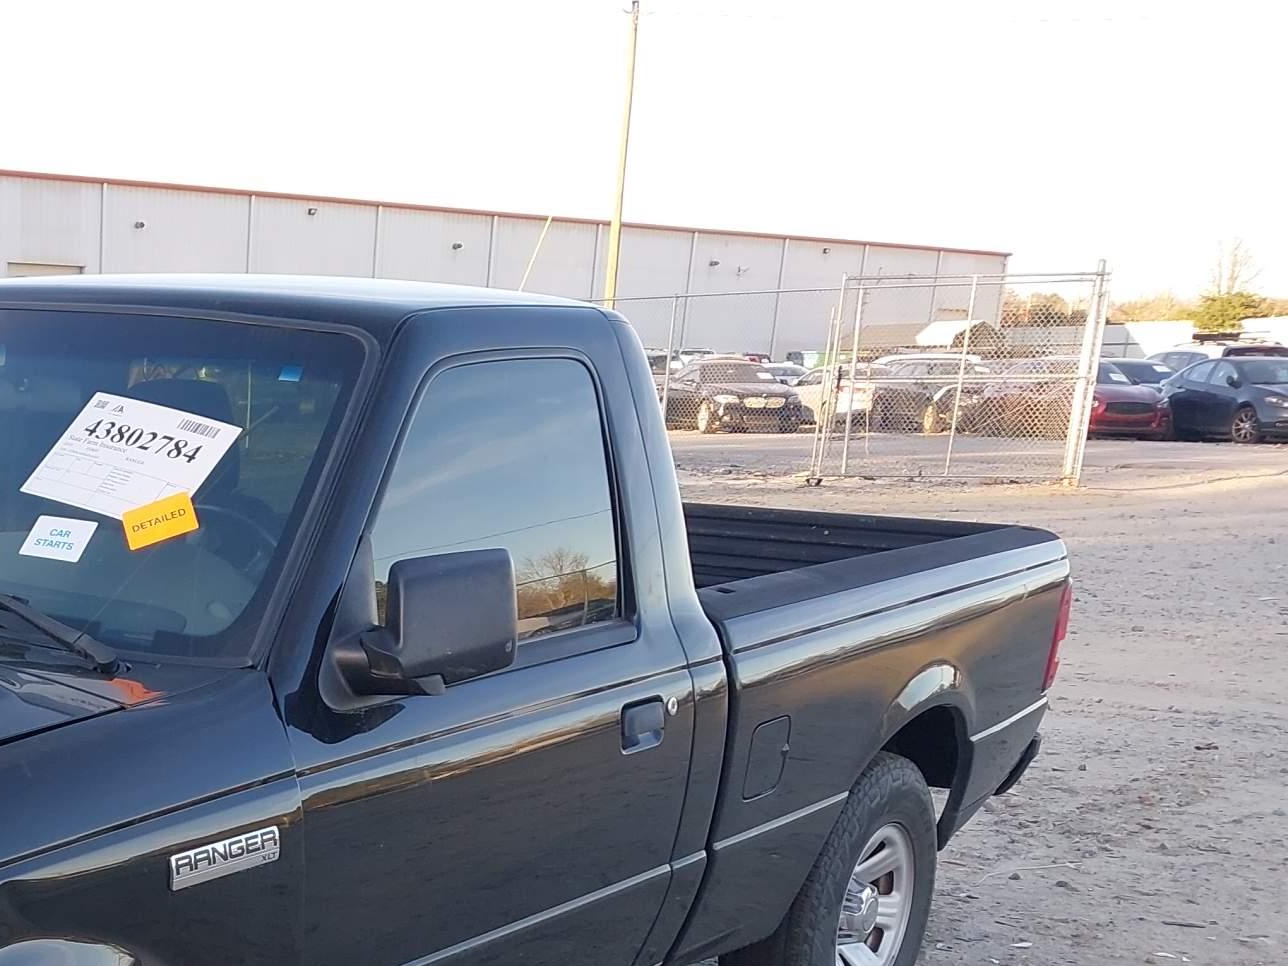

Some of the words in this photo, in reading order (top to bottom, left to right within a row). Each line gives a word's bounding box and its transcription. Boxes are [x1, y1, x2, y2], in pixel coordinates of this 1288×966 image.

[84, 418, 204, 464] 43802784
[49, 528, 72, 538] CAR
[131, 508, 187, 533] DETAILED
[33, 538, 75, 551] STARTS
[175, 829, 278, 876] RANGER
